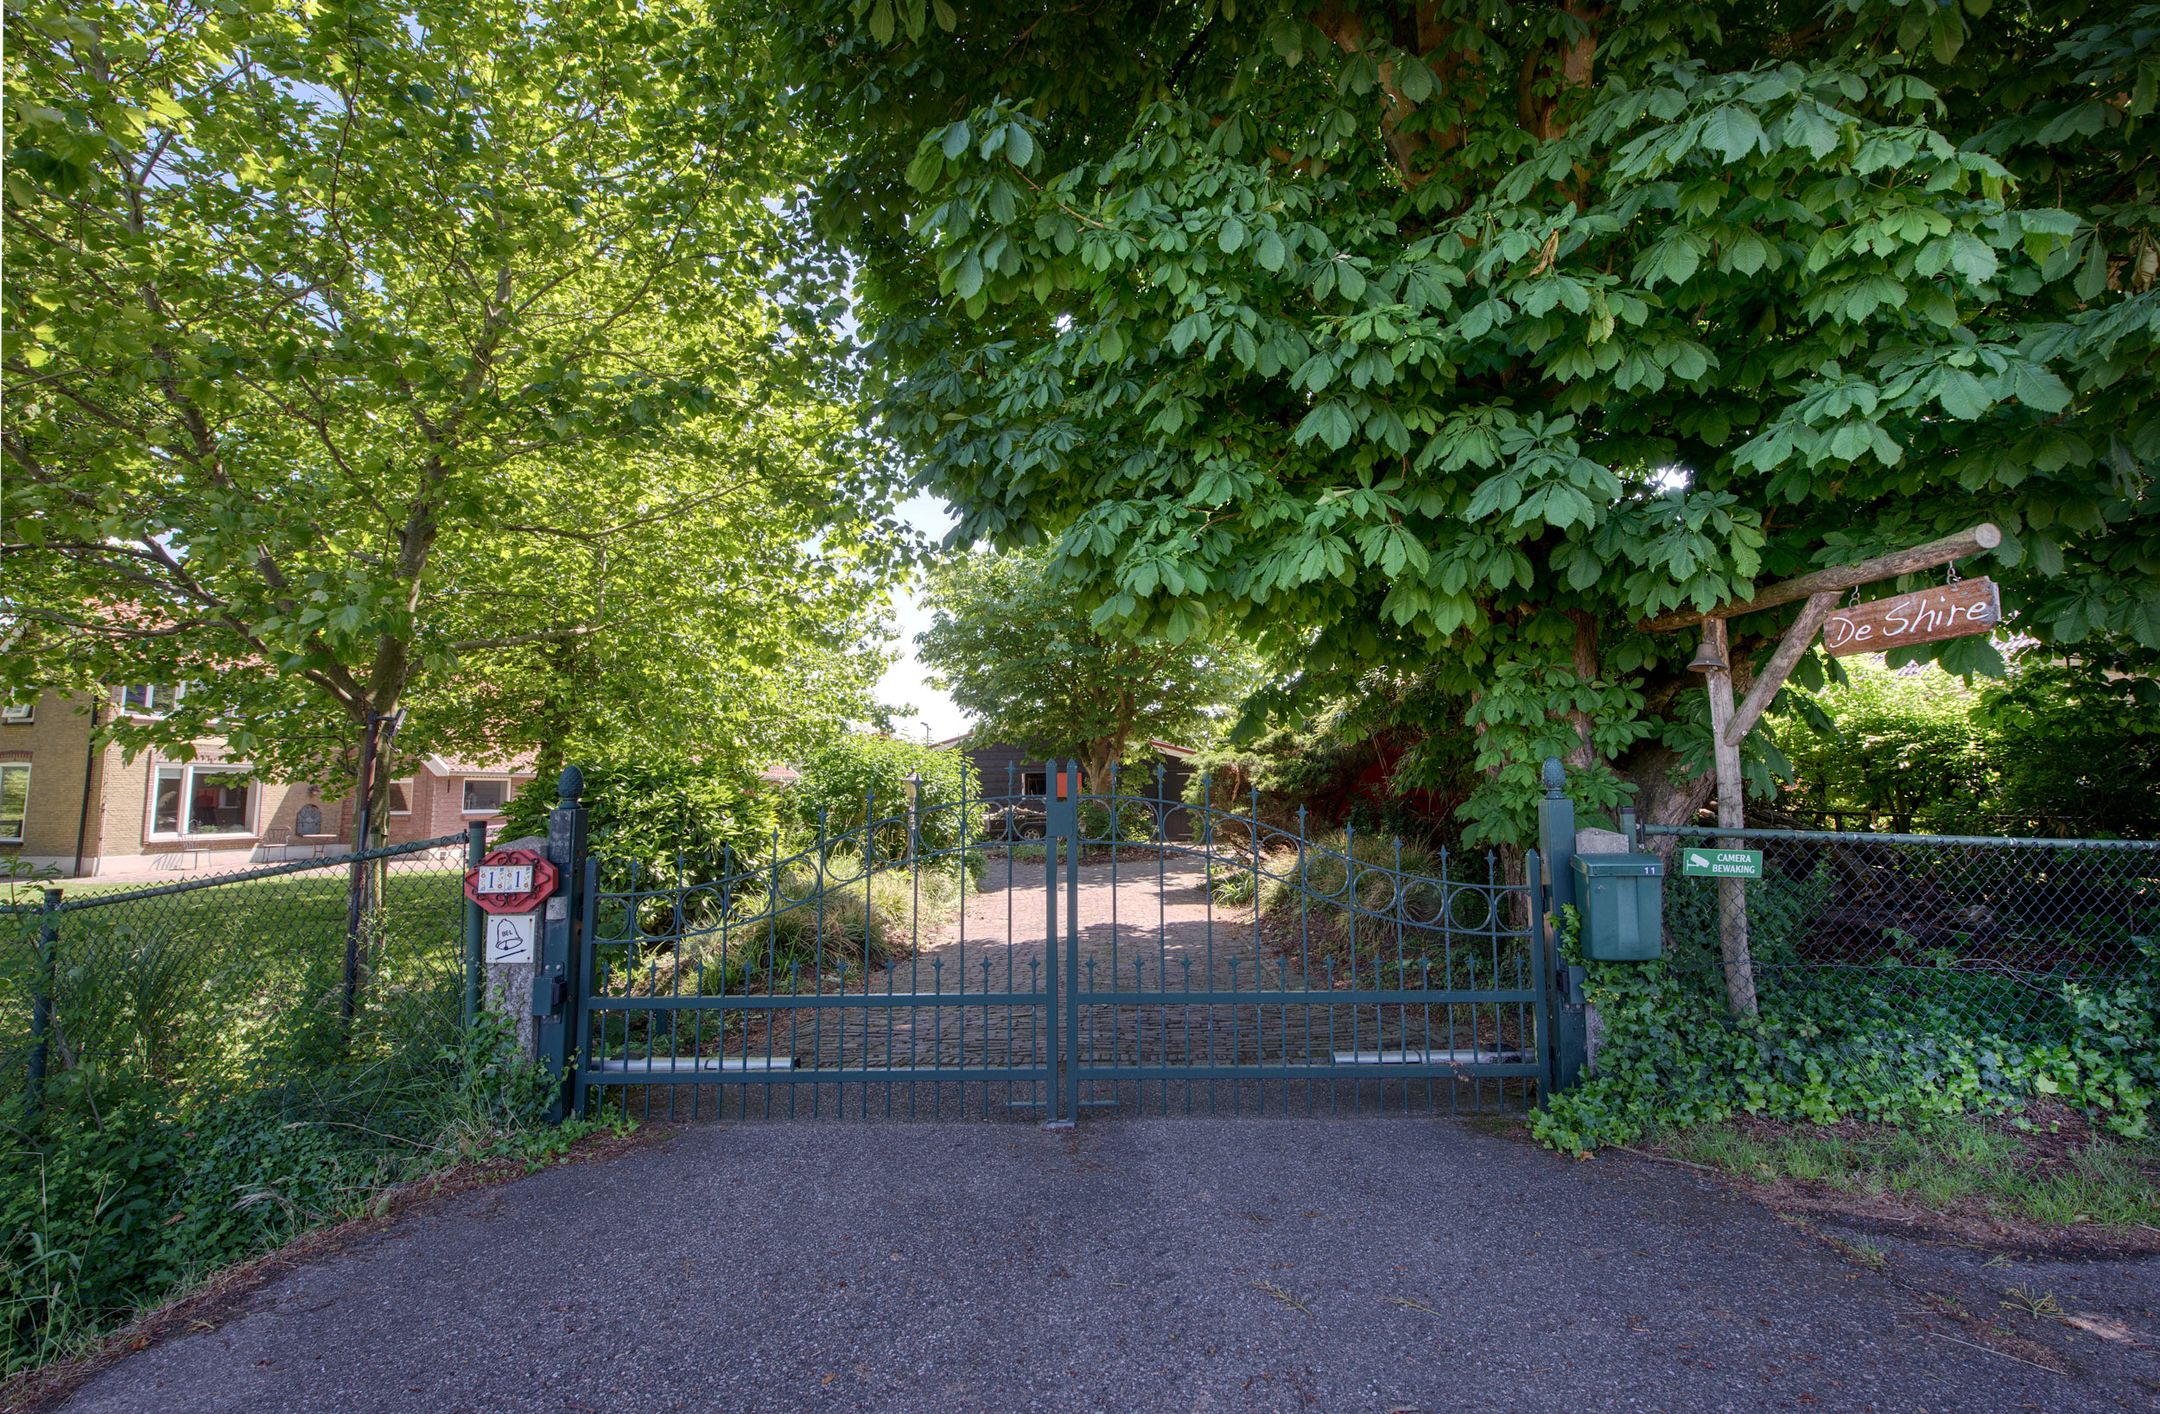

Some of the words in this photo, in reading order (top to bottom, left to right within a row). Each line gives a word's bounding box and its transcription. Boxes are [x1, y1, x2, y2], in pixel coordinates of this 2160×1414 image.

[1830, 617, 1873, 648] De
[1883, 596, 1989, 636] Shire
[1717, 853, 1752, 863] CAMERA
[1644, 867, 1656, 875] 11
[1712, 864, 1756, 874] BEWAKING
